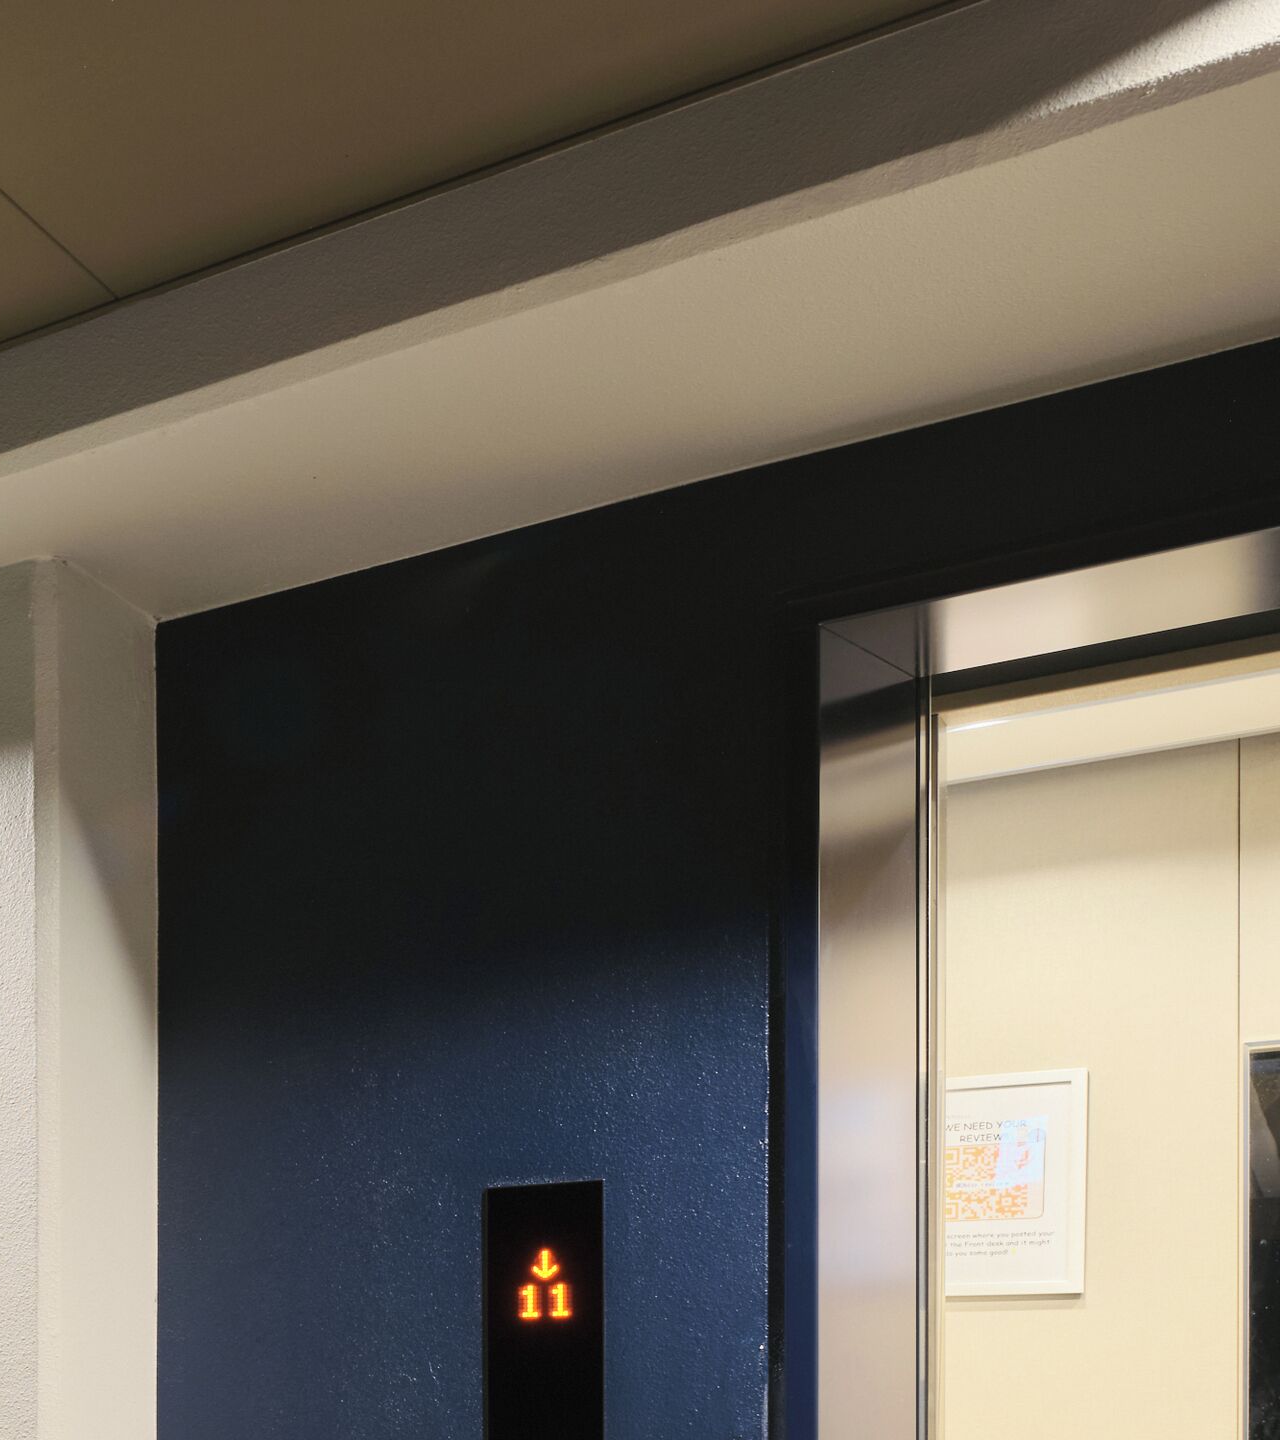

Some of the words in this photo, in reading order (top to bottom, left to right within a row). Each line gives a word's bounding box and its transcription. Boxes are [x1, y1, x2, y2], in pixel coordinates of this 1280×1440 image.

[963, 1122, 993, 1131] NEED
[996, 1119, 1027, 1128] YOUR
[519, 1283, 570, 1319] 11
